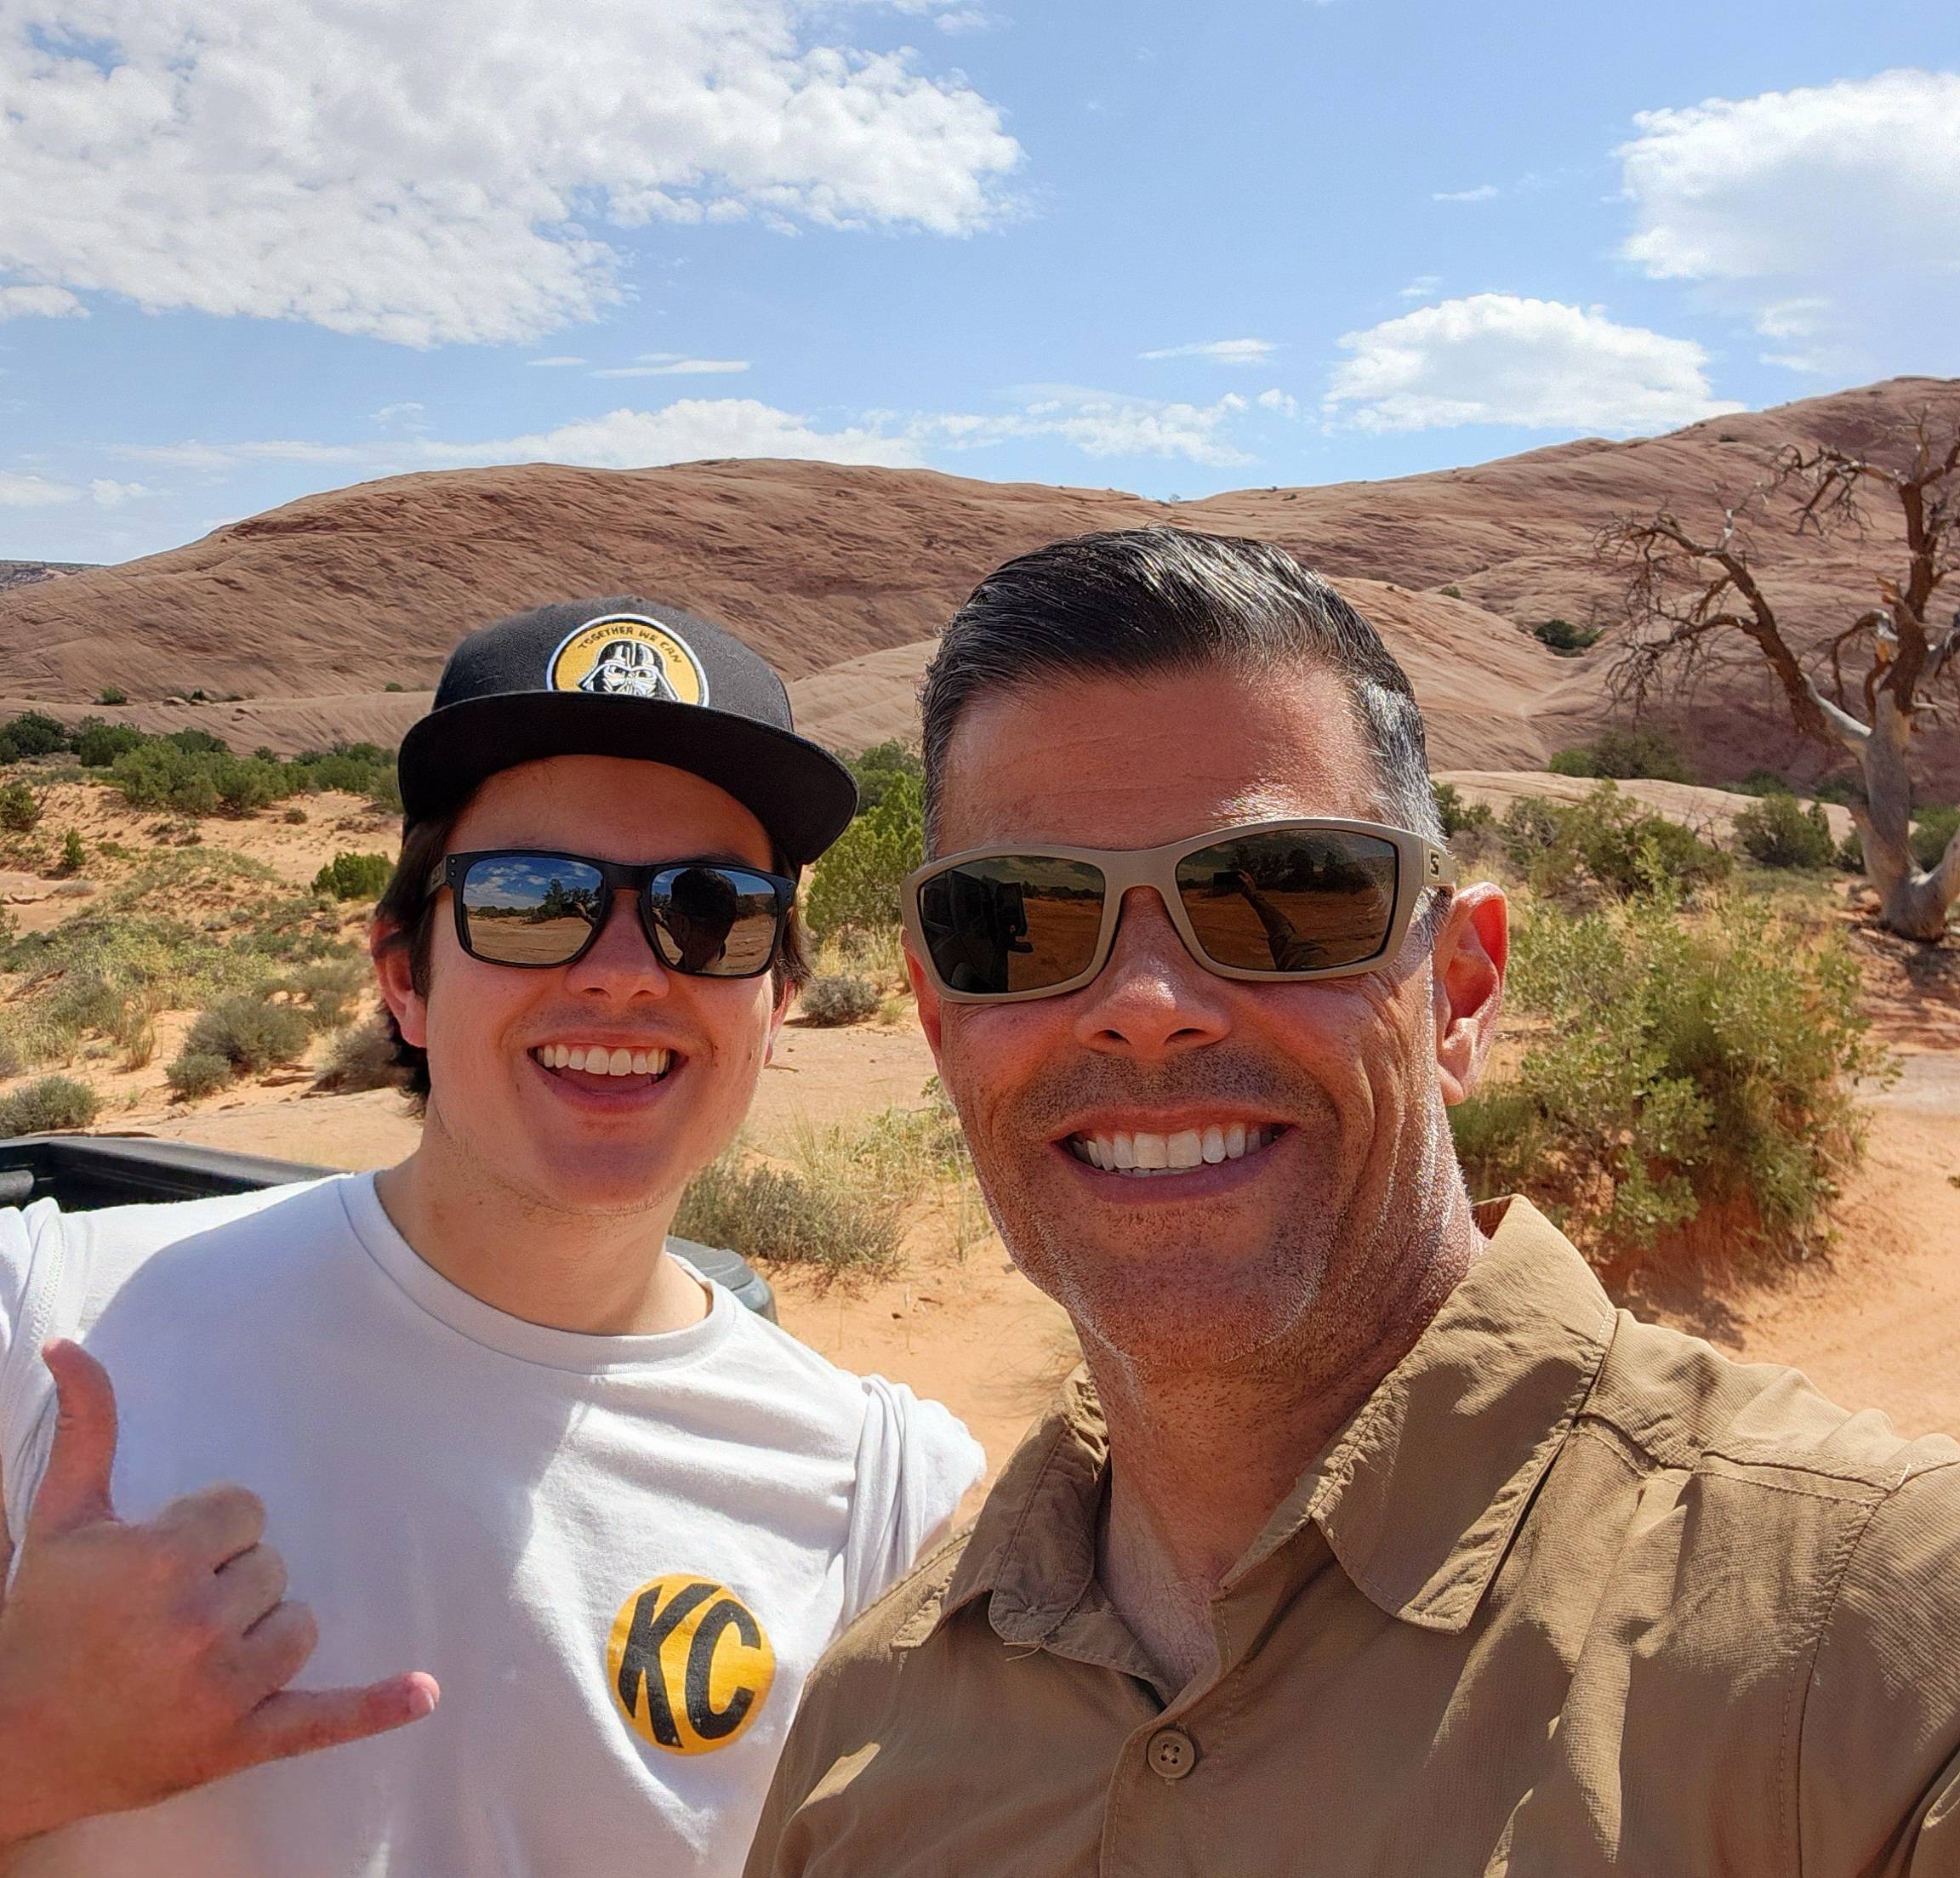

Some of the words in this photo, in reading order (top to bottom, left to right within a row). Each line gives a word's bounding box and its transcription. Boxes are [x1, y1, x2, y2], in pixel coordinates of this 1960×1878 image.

[578, 626, 634, 649] TOGETHER
[638, 629, 658, 641] WE
[659, 640, 683, 663] CAN
[618, 1583, 761, 1749] KC
